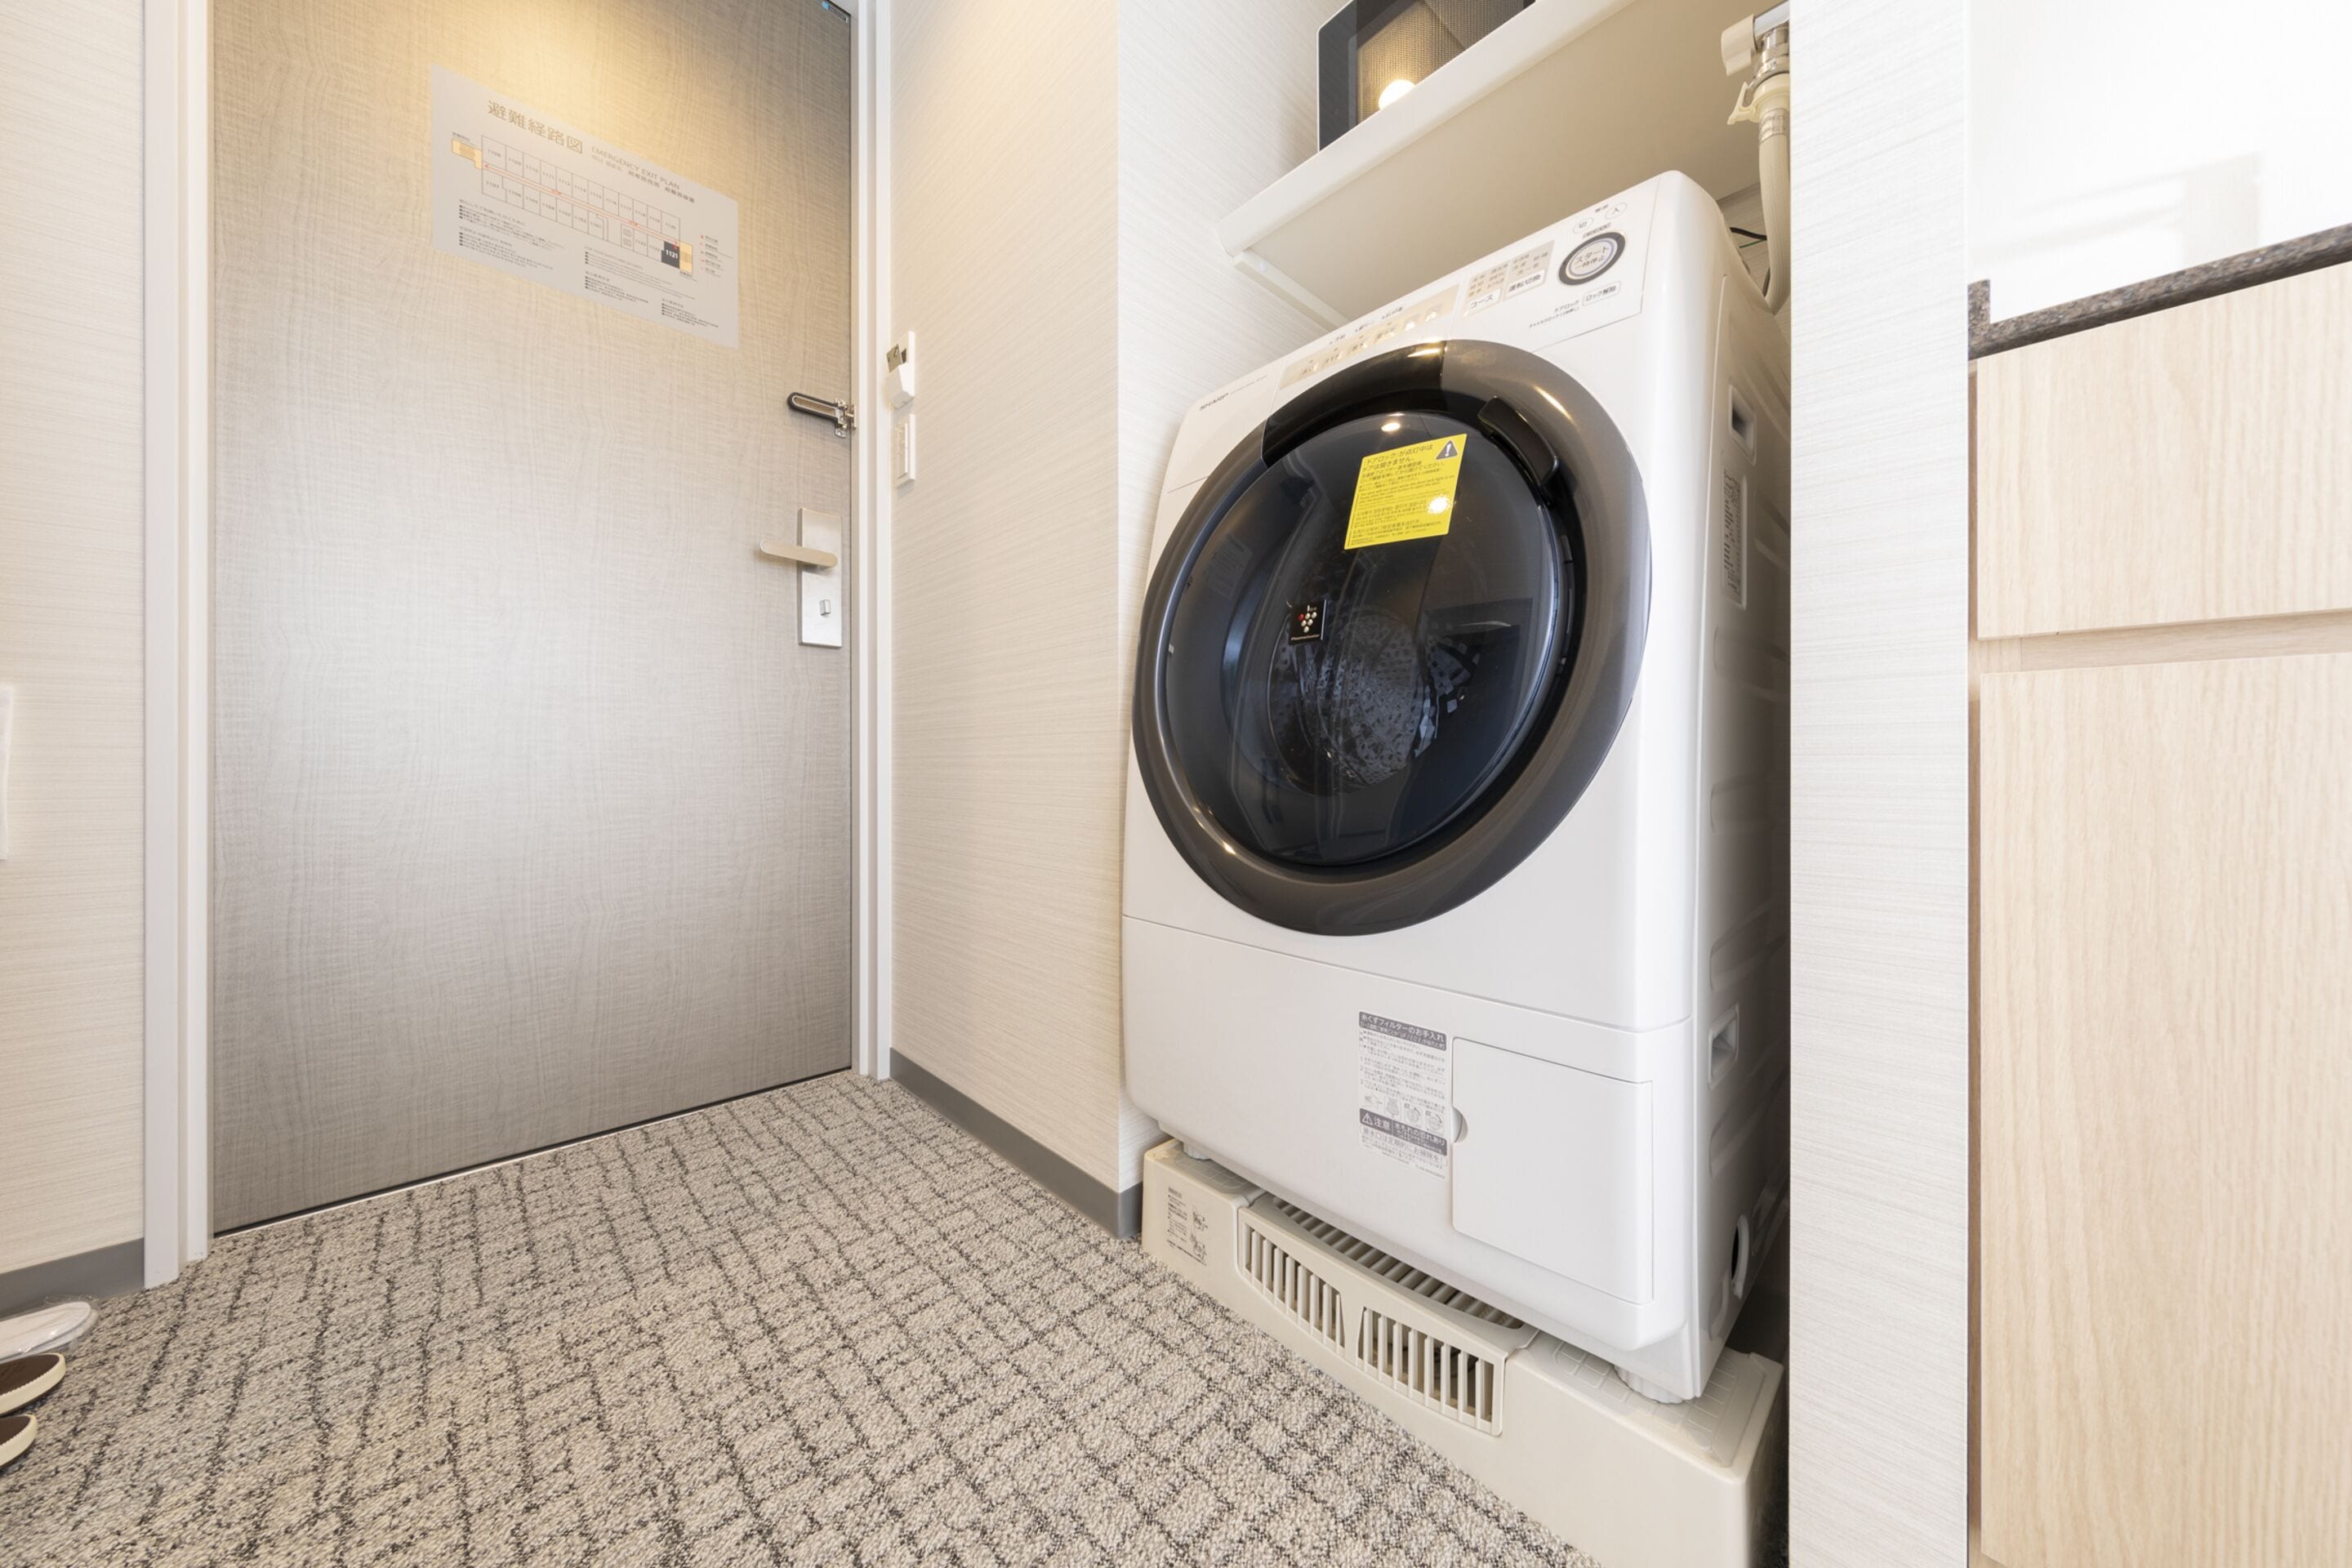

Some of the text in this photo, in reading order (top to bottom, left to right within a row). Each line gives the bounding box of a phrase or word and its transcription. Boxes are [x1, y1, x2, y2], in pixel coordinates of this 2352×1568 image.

[488, 99, 582, 154] 避難経路図
[591, 146, 639, 172] EMERGENCY
[642, 167, 657, 180] EXIT
[660, 176, 679, 190] PLAN
[666, 249, 679, 260] 1121
[1575, 246, 1609, 265] スタート
[1471, 294, 1494, 309] コース
[1585, 286, 1616, 302] ロック解除
[1199, 392, 1229, 411] SHARP
[1374, 1116, 1391, 1131] 注意
